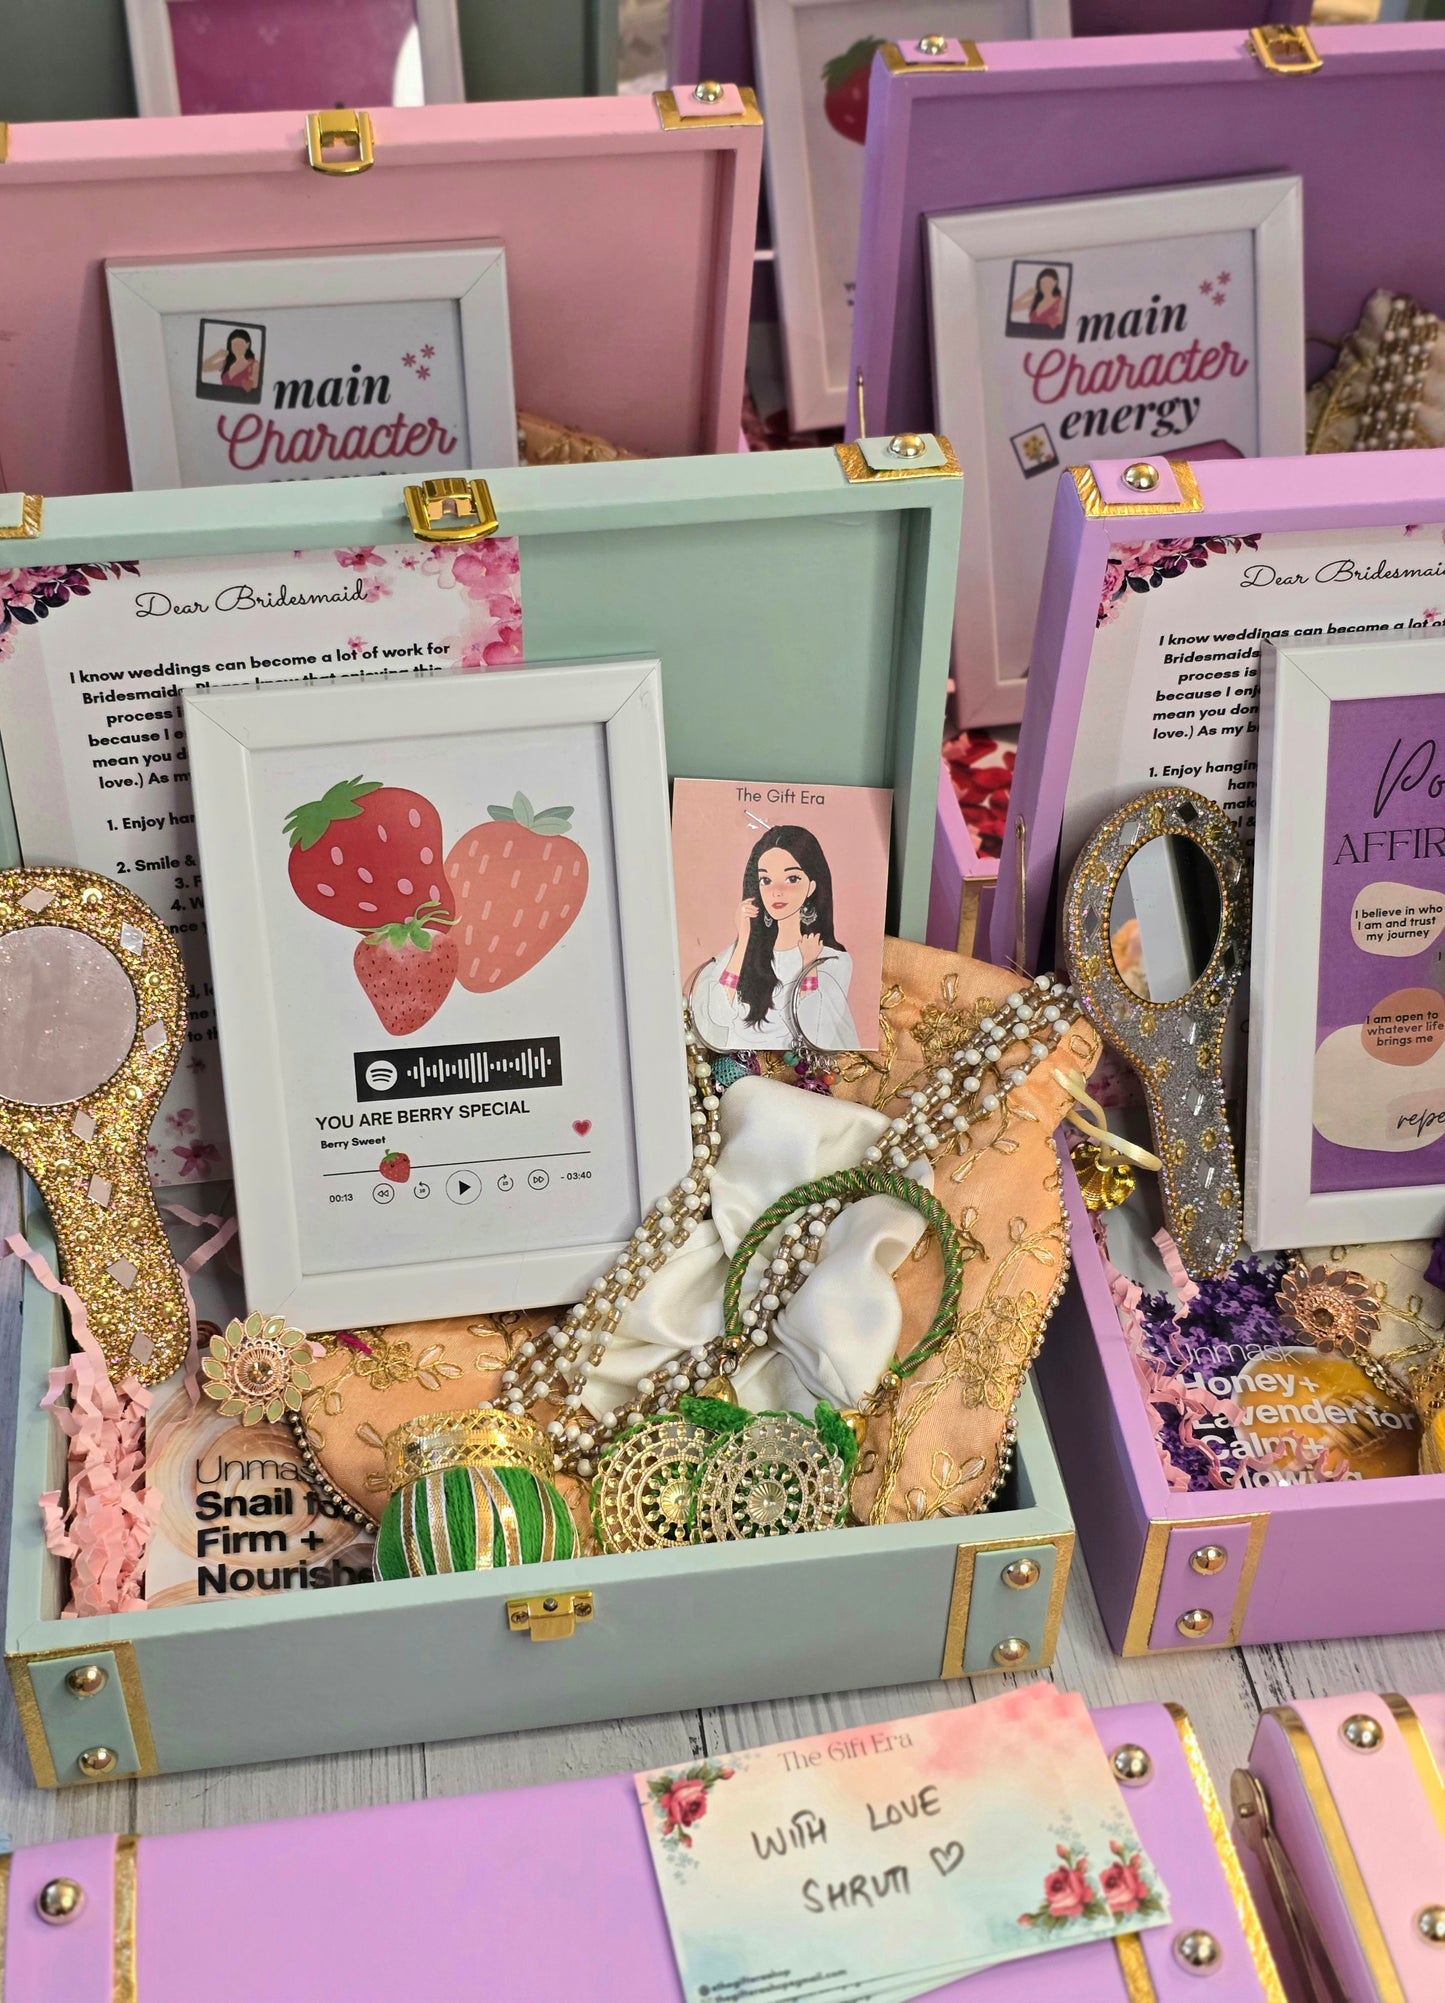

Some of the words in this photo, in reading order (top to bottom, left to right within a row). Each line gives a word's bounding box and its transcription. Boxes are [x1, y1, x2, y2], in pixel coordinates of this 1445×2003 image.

[1077, 295, 1187, 343] main
[1023, 339, 1249, 404] Character
[273, 364, 391, 409] main
[1059, 396, 1201, 438] energy
[217, 412, 458, 470] Character
[1239, 564, 1310, 589] Dear
[135, 591, 209, 618] Dear
[215, 578, 368, 612] Bridesmaid
[1159, 635, 1165, 646] I
[1168, 633, 1210, 646] know
[1294, 627, 1323, 637] can
[1327, 623, 1390, 634] become
[69, 672, 76, 684] I
[79, 670, 124, 683] know
[128, 663, 211, 678] weddings
[215, 660, 246, 672] can
[250, 656, 317, 669] become
[321, 653, 332, 663] a
[336, 648, 358, 662] lot
[362, 646, 379, 660] of
[382, 643, 423, 658] work
[427, 642, 451, 655] for
[1177, 669, 1241, 685] process
[1244, 666, 1257, 677] is
[1155, 689, 1222, 702] because
[1225, 686, 1232, 697] I
[106, 709, 173, 728] process
[1152, 710, 1195, 721] mean
[1199, 707, 1226, 721] you
[88, 733, 160, 747] because
[164, 728, 170, 740] I
[1152, 725, 1194, 740] love.)
[1197, 725, 1218, 736] As
[1221, 725, 1244, 737] my
[92, 755, 139, 768] mean
[142, 752, 172, 768] you
[98, 771, 144, 789] love.)
[148, 772, 170, 784] As
[1148, 766, 1158, 778] 1.
[1162, 764, 1202, 779] Enjoy
[736, 787, 762, 802] The
[767, 788, 796, 804] Gift
[800, 790, 825, 805] Era
[106, 819, 118, 831] 1.
[122, 815, 166, 831] Enjoy
[116, 861, 131, 874] 2.
[134, 855, 180, 872] Smile
[184, 854, 197, 867] &
[174, 877, 190, 889] 3.
[1355, 910, 1359, 919] I
[1361, 908, 1402, 919] believe
[1405, 906, 1415, 916] in
[1418, 904, 1443, 914] who
[1358, 921, 1361, 931] I
[1364, 921, 1382, 930] am
[1385, 917, 1407, 929] and
[1410, 916, 1437, 927] trust
[1366, 933, 1383, 943] my
[1386, 929, 1430, 942] journey
[1366, 1015, 1370, 1024] I
[1373, 1015, 1392, 1024] am
[1395, 1013, 1424, 1024] open
[1426, 1010, 1439, 1020] to
[1367, 1023, 1423, 1036] whatever
[1425, 1020, 1445, 1032] life
[1376, 1036, 1413, 1047] brings
[1415, 1035, 1434, 1044] me
[315, 1114, 354, 1131] YOU
[358, 1110, 393, 1128] ARE
[397, 1106, 454, 1124] BERRY
[458, 1100, 530, 1119] SPECIAL
[320, 1139, 349, 1150] Berry
[351, 1135, 386, 1147] Sweet
[329, 1193, 354, 1203] 00:13
[566, 1171, 592, 1182] 03:40
[1164, 1342, 1302, 1367] Unmask
[1178, 1371, 1295, 1397] Honey
[1361, 1403, 1418, 1431] for
[195, 1487, 293, 1521] Snail
[197, 1525, 287, 1558] Firm
[778, 1749, 822, 1773] The
[827, 1737, 868, 1765] Gift
[872, 1728, 914, 1756] Era
[751, 1808, 828, 1860] WITH
[866, 1785, 942, 1831] LOVE
